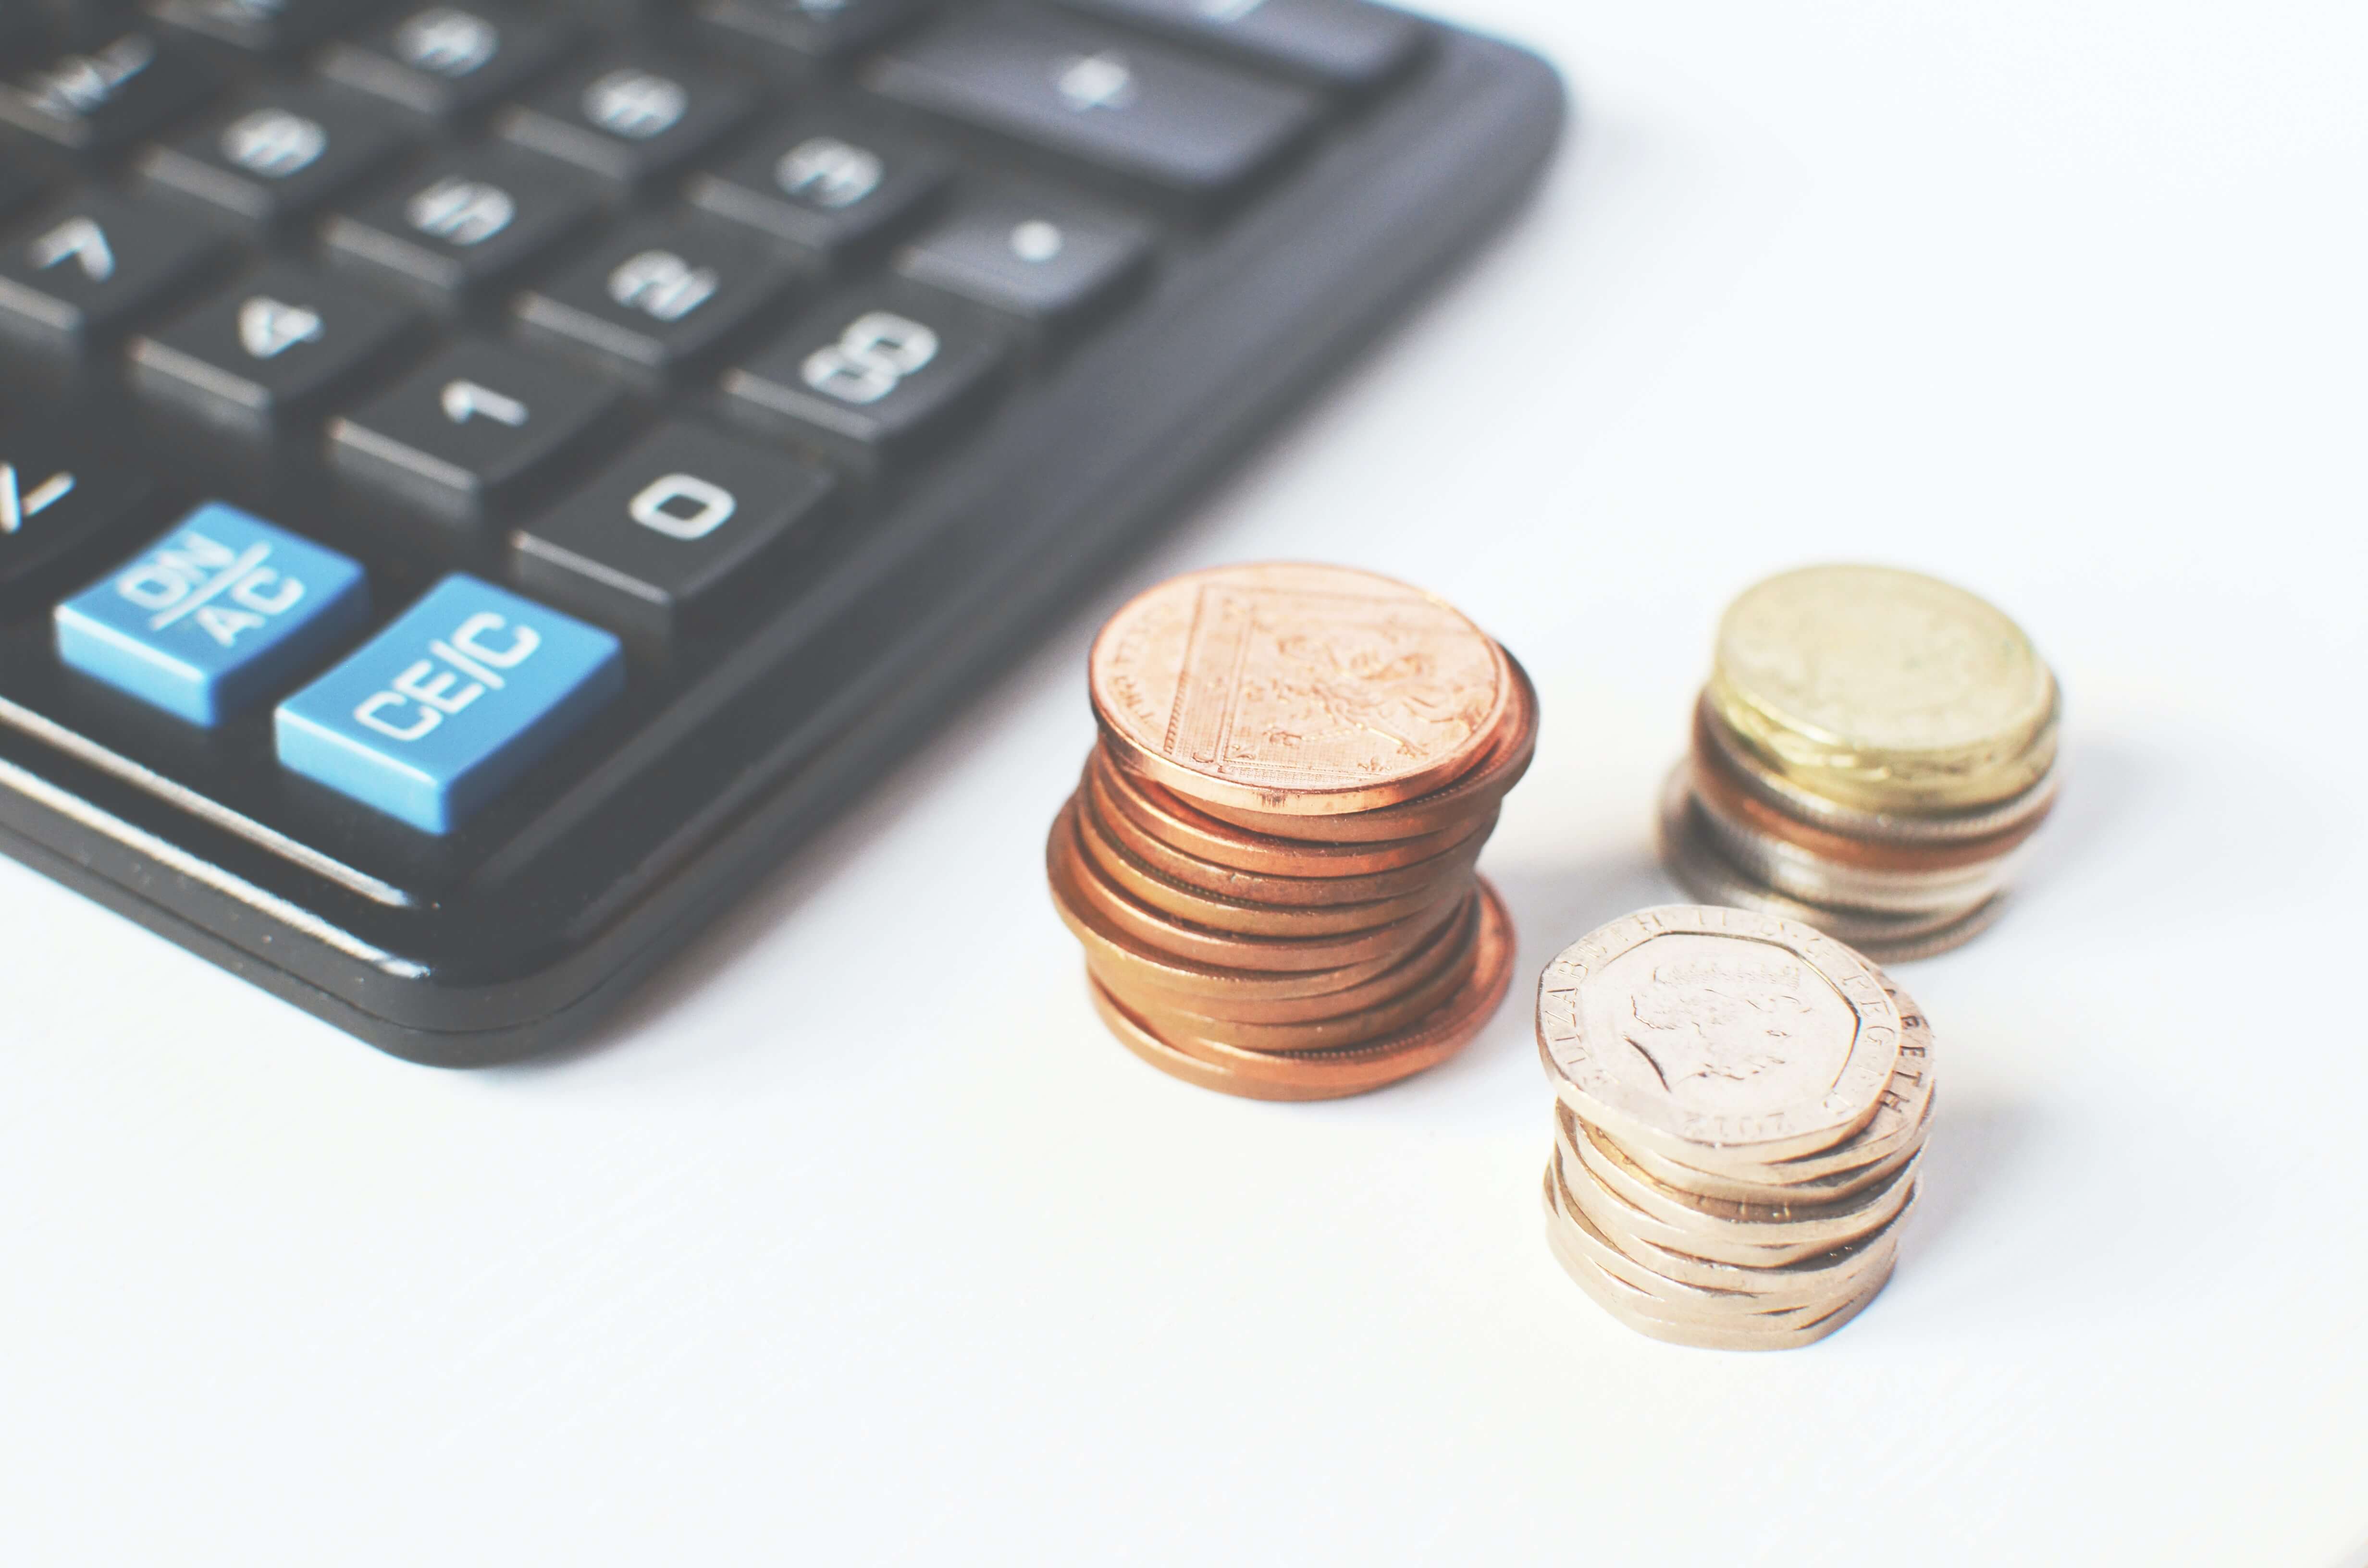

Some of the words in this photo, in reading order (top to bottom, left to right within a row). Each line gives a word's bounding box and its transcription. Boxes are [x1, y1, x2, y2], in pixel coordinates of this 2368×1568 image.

[28, 215, 115, 282] 7
[606, 250, 718, 323] 2
[238, 296, 324, 359] 4
[441, 380, 528, 426] 1
[627, 473, 737, 541] 0
[116, 531, 235, 609] ON
[196, 566, 306, 648] AC
